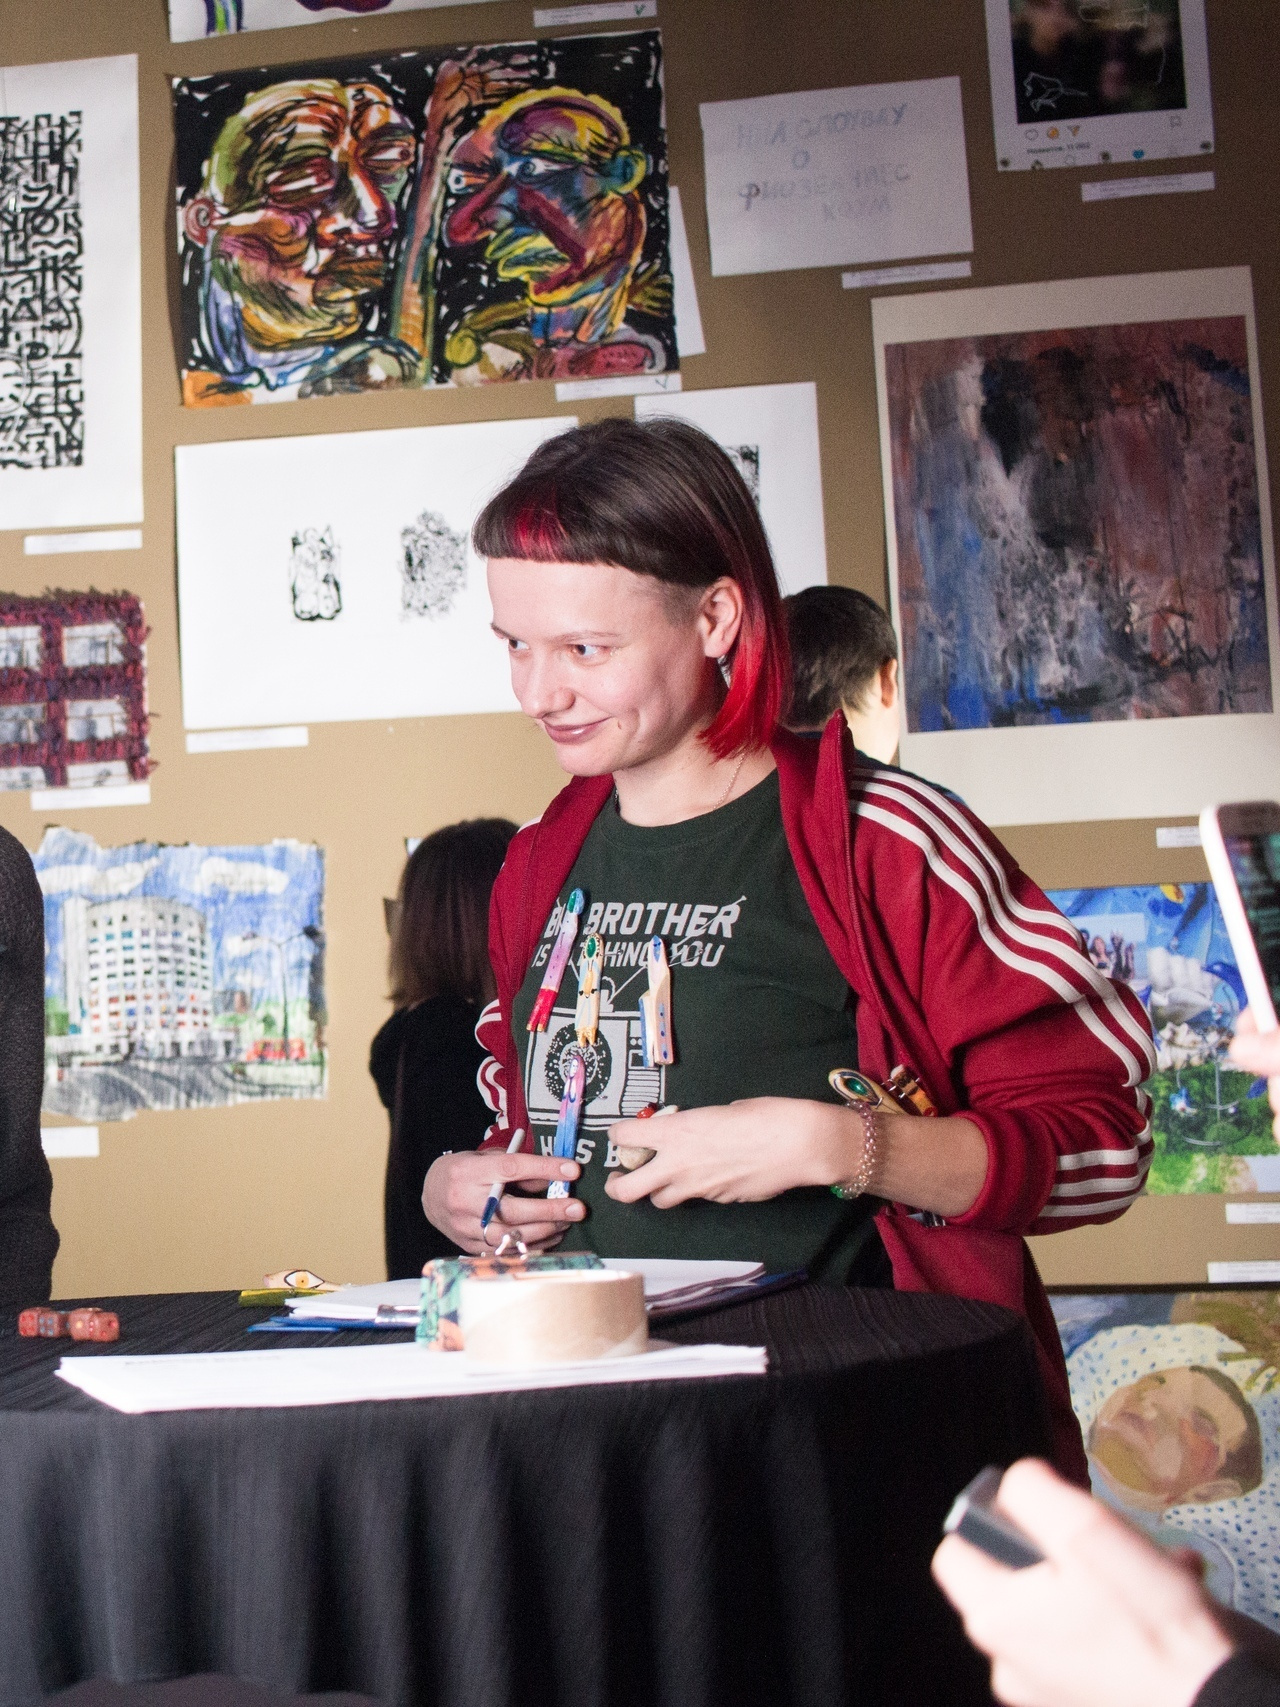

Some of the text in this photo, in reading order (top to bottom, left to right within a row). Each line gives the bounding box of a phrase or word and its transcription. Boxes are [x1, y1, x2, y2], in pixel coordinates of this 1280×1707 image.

[583, 901, 741, 938] BROTHER
[531, 943, 551, 968] IS
[670, 940, 726, 967] YOU
